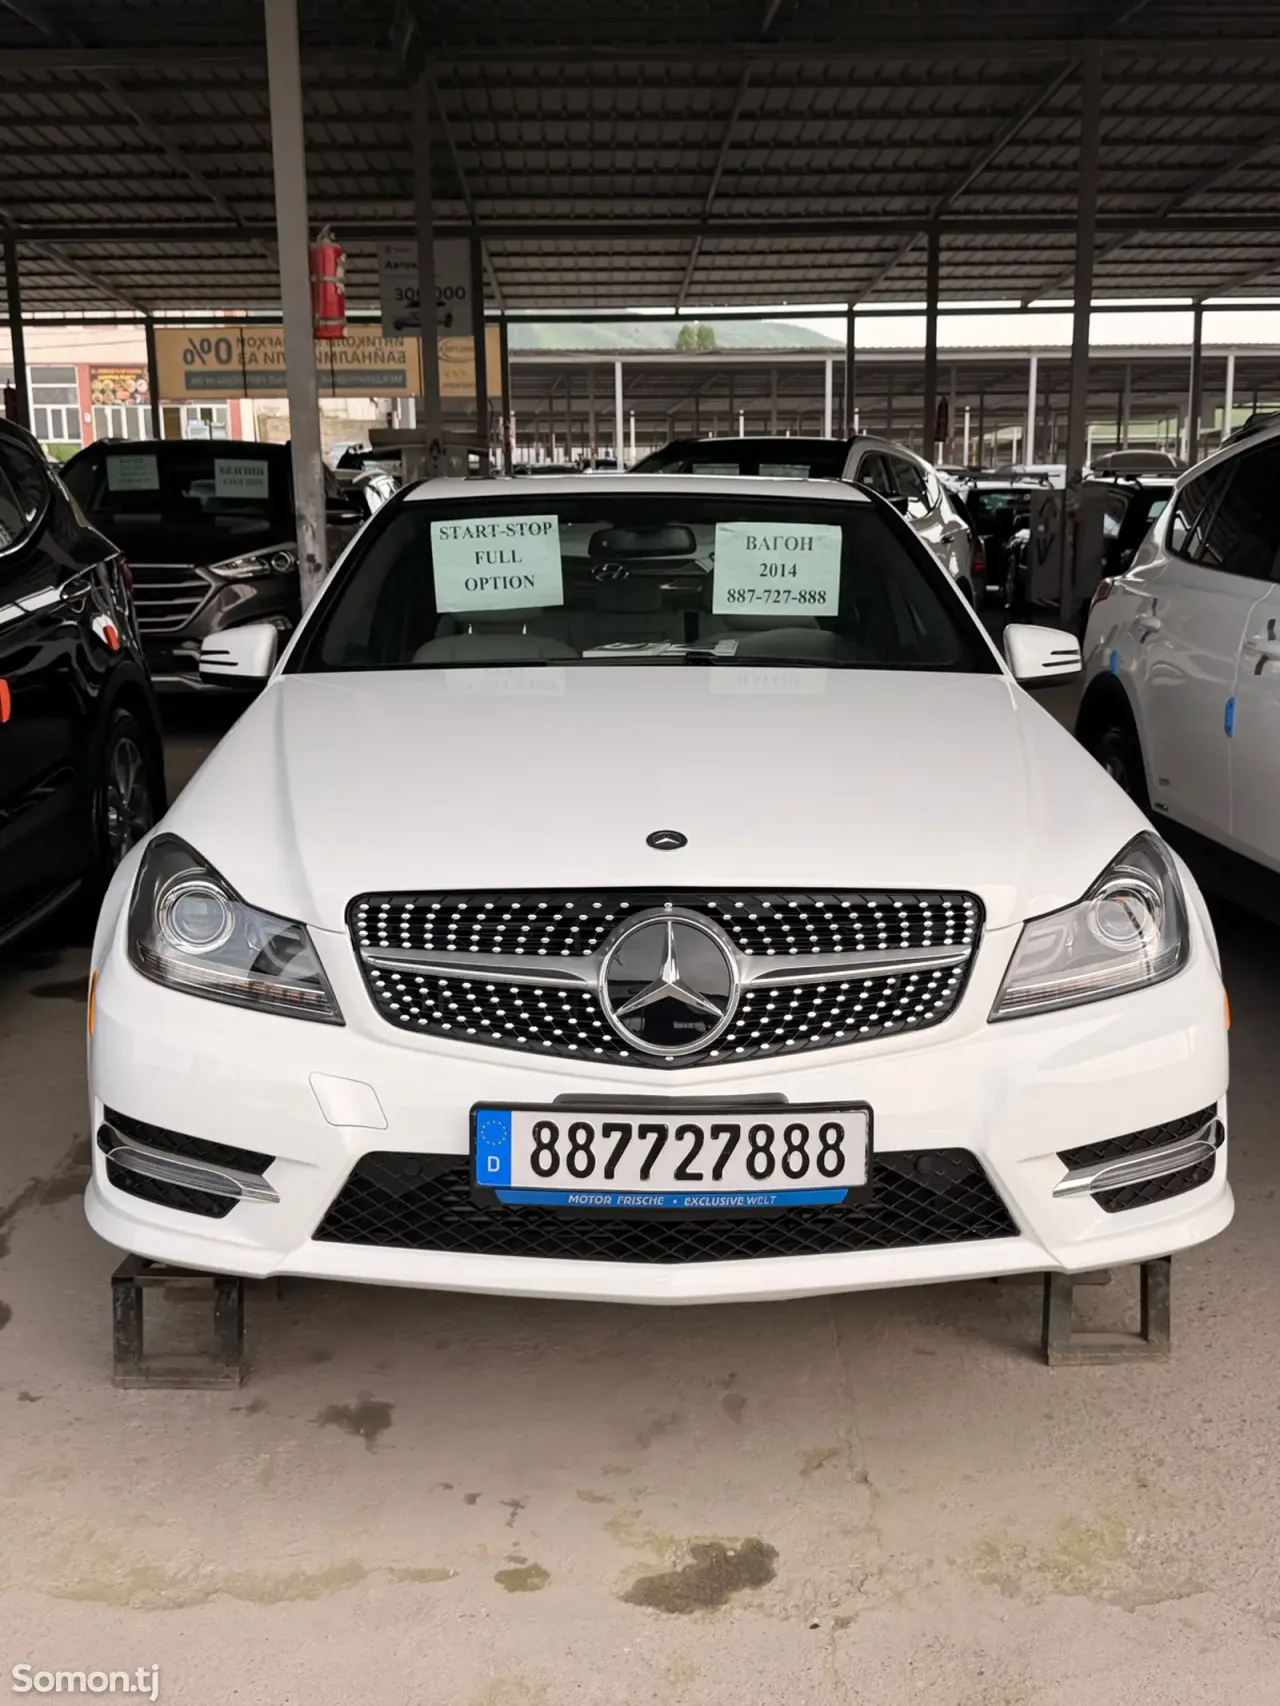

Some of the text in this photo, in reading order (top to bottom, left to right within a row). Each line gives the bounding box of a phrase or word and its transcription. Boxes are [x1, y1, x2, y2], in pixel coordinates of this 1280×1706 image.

[439, 521, 553, 541] START-STOP
[745, 535, 813, 552] ВАГОН
[475, 549, 523, 565] FULL
[759, 562, 797, 578] 2014
[464, 574, 535, 592] OPTION
[726, 588, 827, 605] 887-727-888
[530, 1120, 846, 1182] 887727888
[487, 1155, 500, 1173] D
[568, 1194, 777, 1206] MOTOR FRISCHE EXCLUSIVE WELT
